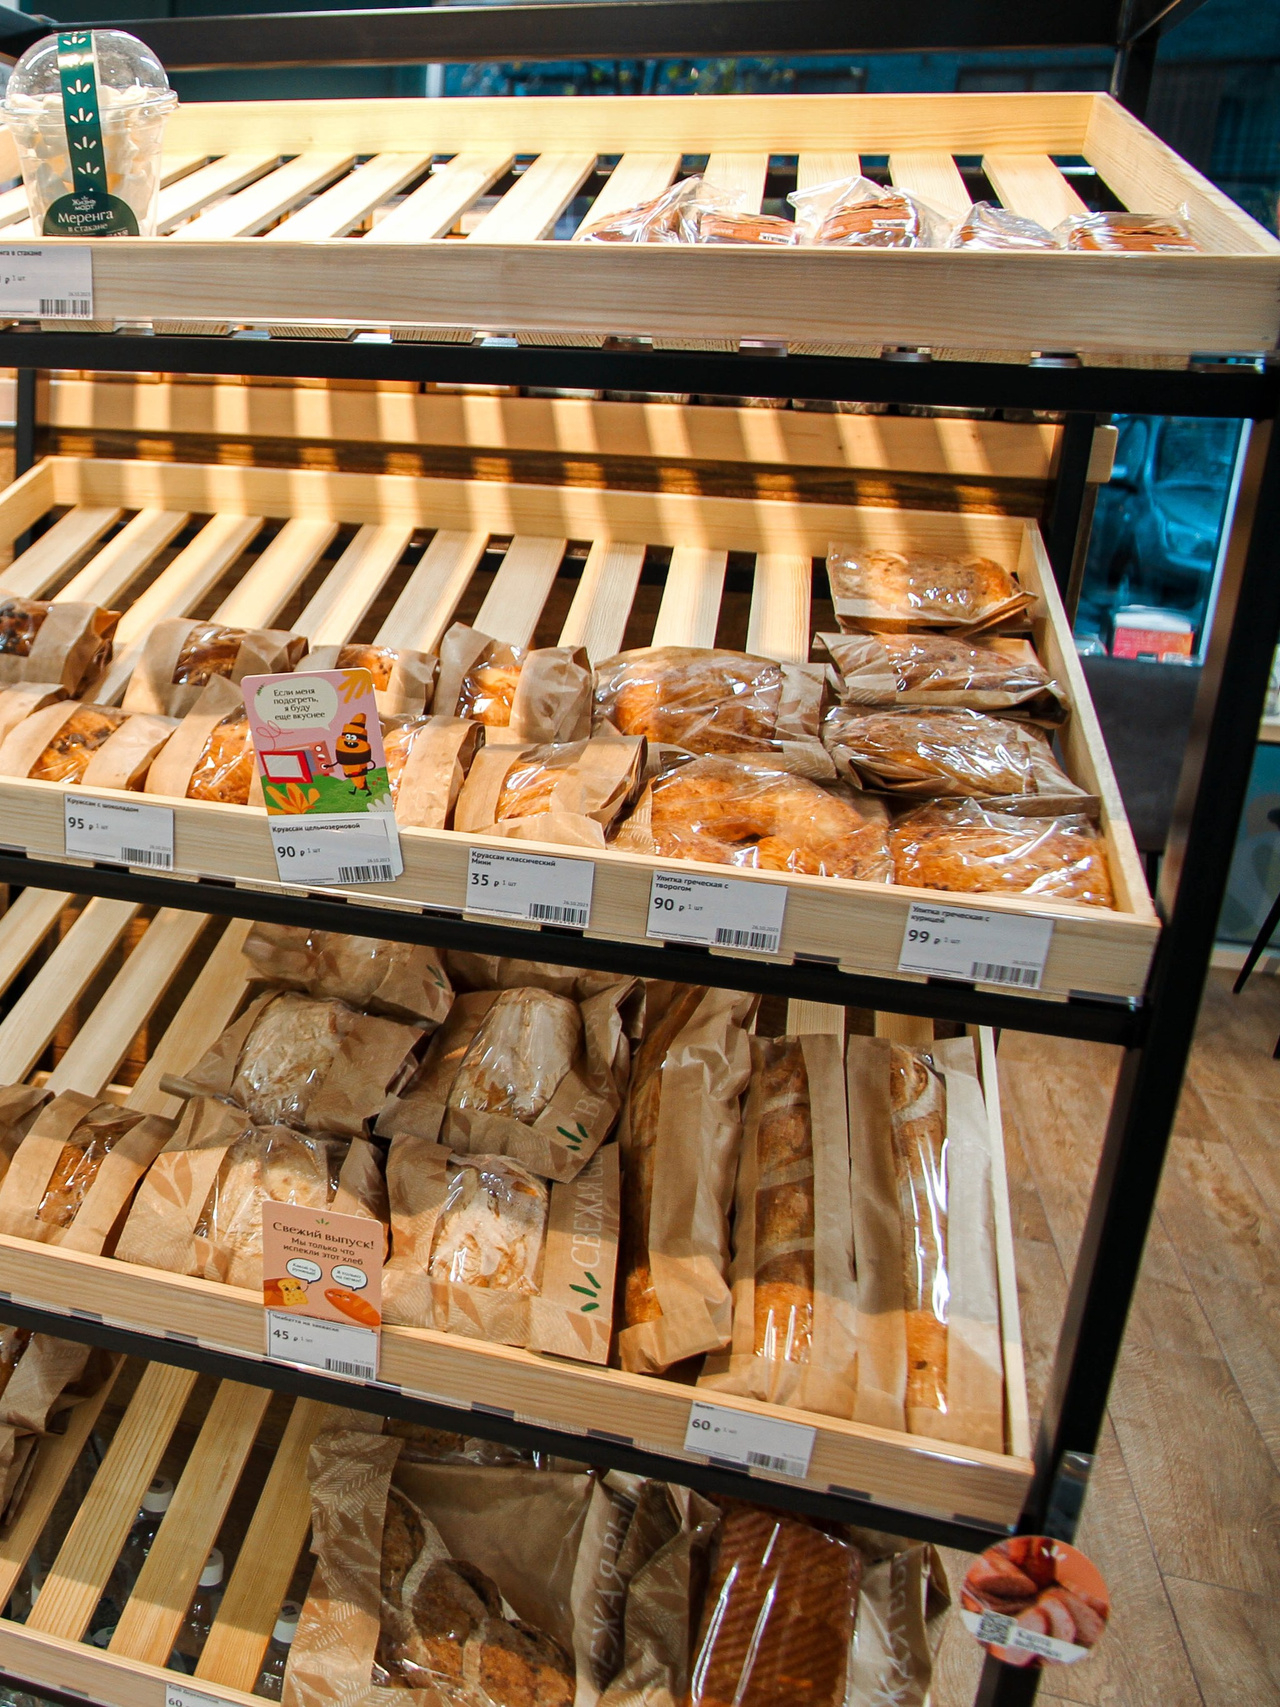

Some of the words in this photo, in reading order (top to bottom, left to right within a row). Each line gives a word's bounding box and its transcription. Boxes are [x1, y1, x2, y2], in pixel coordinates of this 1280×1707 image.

[58, 210, 114, 226] Меренга
[273, 689, 294, 697] Если
[295, 687, 316, 696] меня
[290, 704, 311, 713] буду
[274, 713, 292, 721] еще
[293, 711, 326, 720] вкуснее
[67, 797, 96, 806] Круассан
[102, 803, 139, 812] шоколадом
[68, 816, 84, 829] 95
[272, 825, 303, 833] Круассан
[304, 822, 360, 832] цельнозерновой
[277, 846, 295, 858] 90
[471, 851, 505, 860] Круассан
[506, 855, 556, 867] классический
[471, 858, 491, 866] Мини
[471, 873, 489, 886] 35
[656, 874, 682, 883] Улитка
[683, 878, 722, 888] греческая
[655, 882, 692, 891] творогом
[654, 897, 674, 911] 90
[911, 914, 945, 924] курицей
[913, 906, 940, 916] Улитка
[942, 911, 983, 921] греческая
[908, 929, 930, 943] 99
[571, 1181, 605, 1269] СВЕЖАЯ
[272, 1221, 322, 1240] Свежий
[324, 1233, 374, 1250] выпуск!
[291, 1237, 307, 1247] Мы
[308, 1241, 338, 1252] только
[340, 1248, 355, 1256] что
[283, 1244, 320, 1257] испекли
[321, 1253, 341, 1261] этот
[342, 1256, 364, 1266] хлеб
[272, 1329, 289, 1340] 45
[692, 1419, 711, 1431] 60
[168, 1697, 183, 1707] 60
